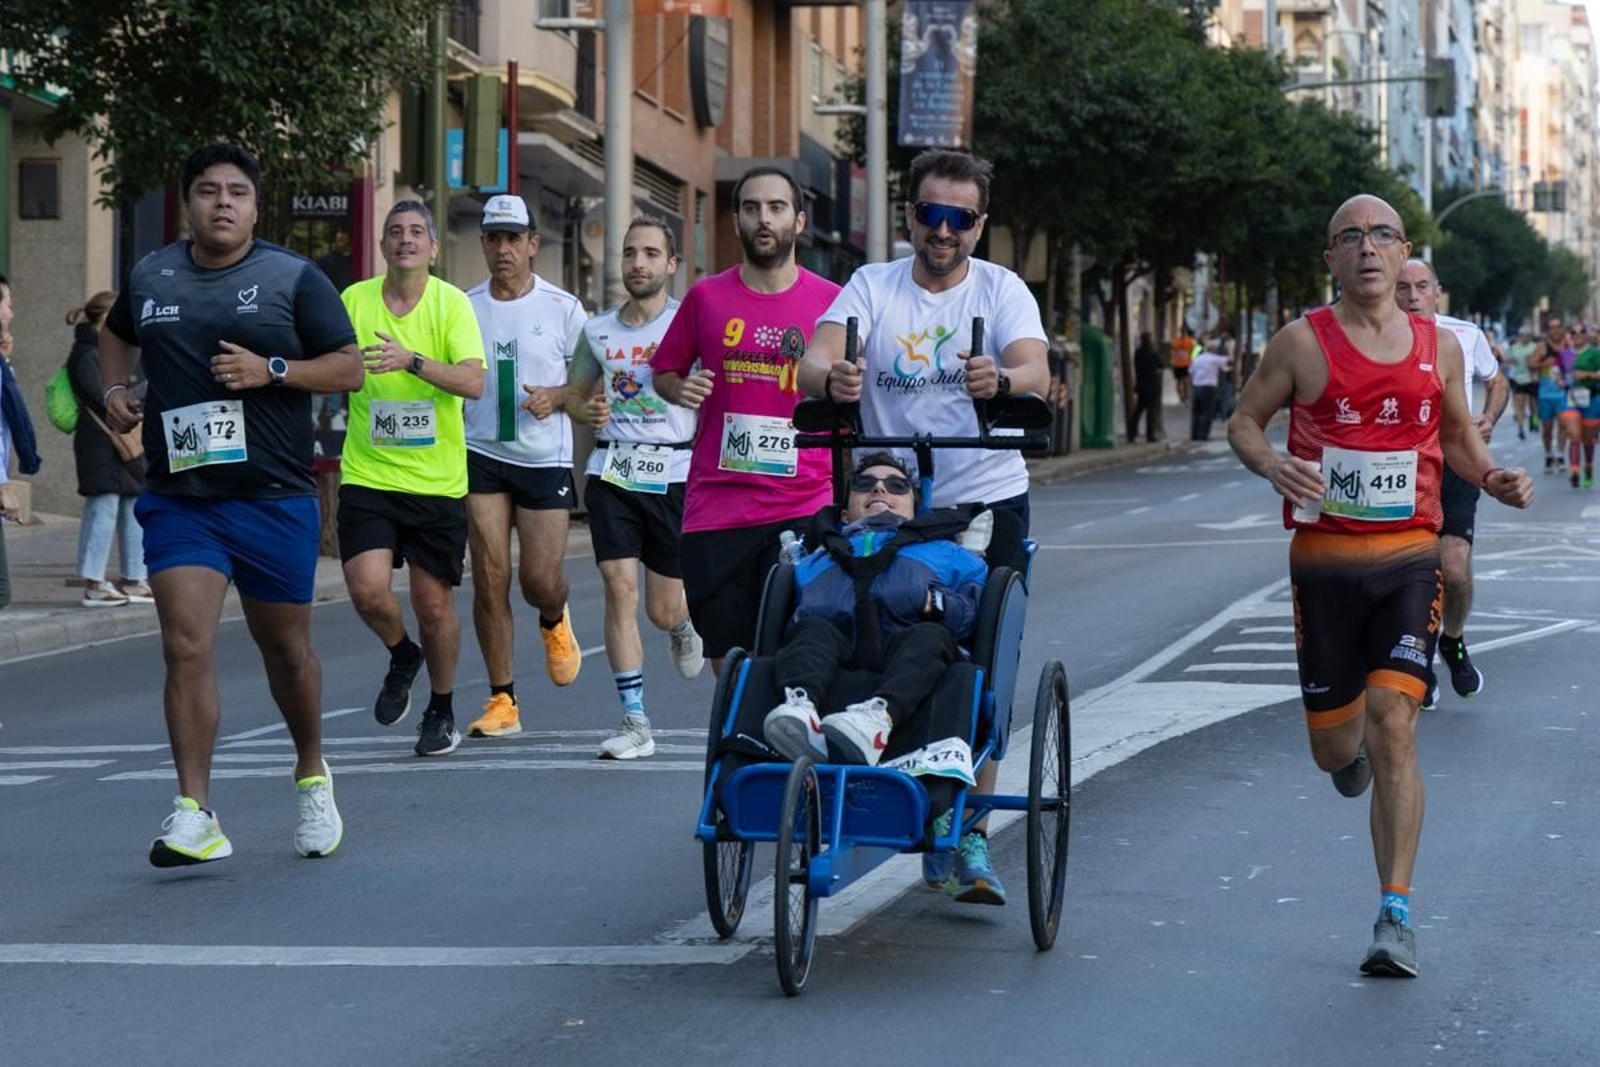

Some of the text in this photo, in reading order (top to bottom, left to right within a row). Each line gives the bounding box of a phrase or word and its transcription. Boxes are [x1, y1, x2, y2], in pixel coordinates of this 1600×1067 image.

[292, 195, 348, 210] KIABI
[155, 305, 179, 317] LCH
[723, 317, 746, 347] 9
[605, 346, 658, 360] LA PA
[876, 371, 927, 392] Equipo
[930, 368, 967, 385] Juli
[402, 415, 430, 427] 235
[203, 420, 237, 438] 172
[758, 435, 791, 450] 276
[637, 460, 664, 473] 260
[1369, 473, 1407, 490] 418
